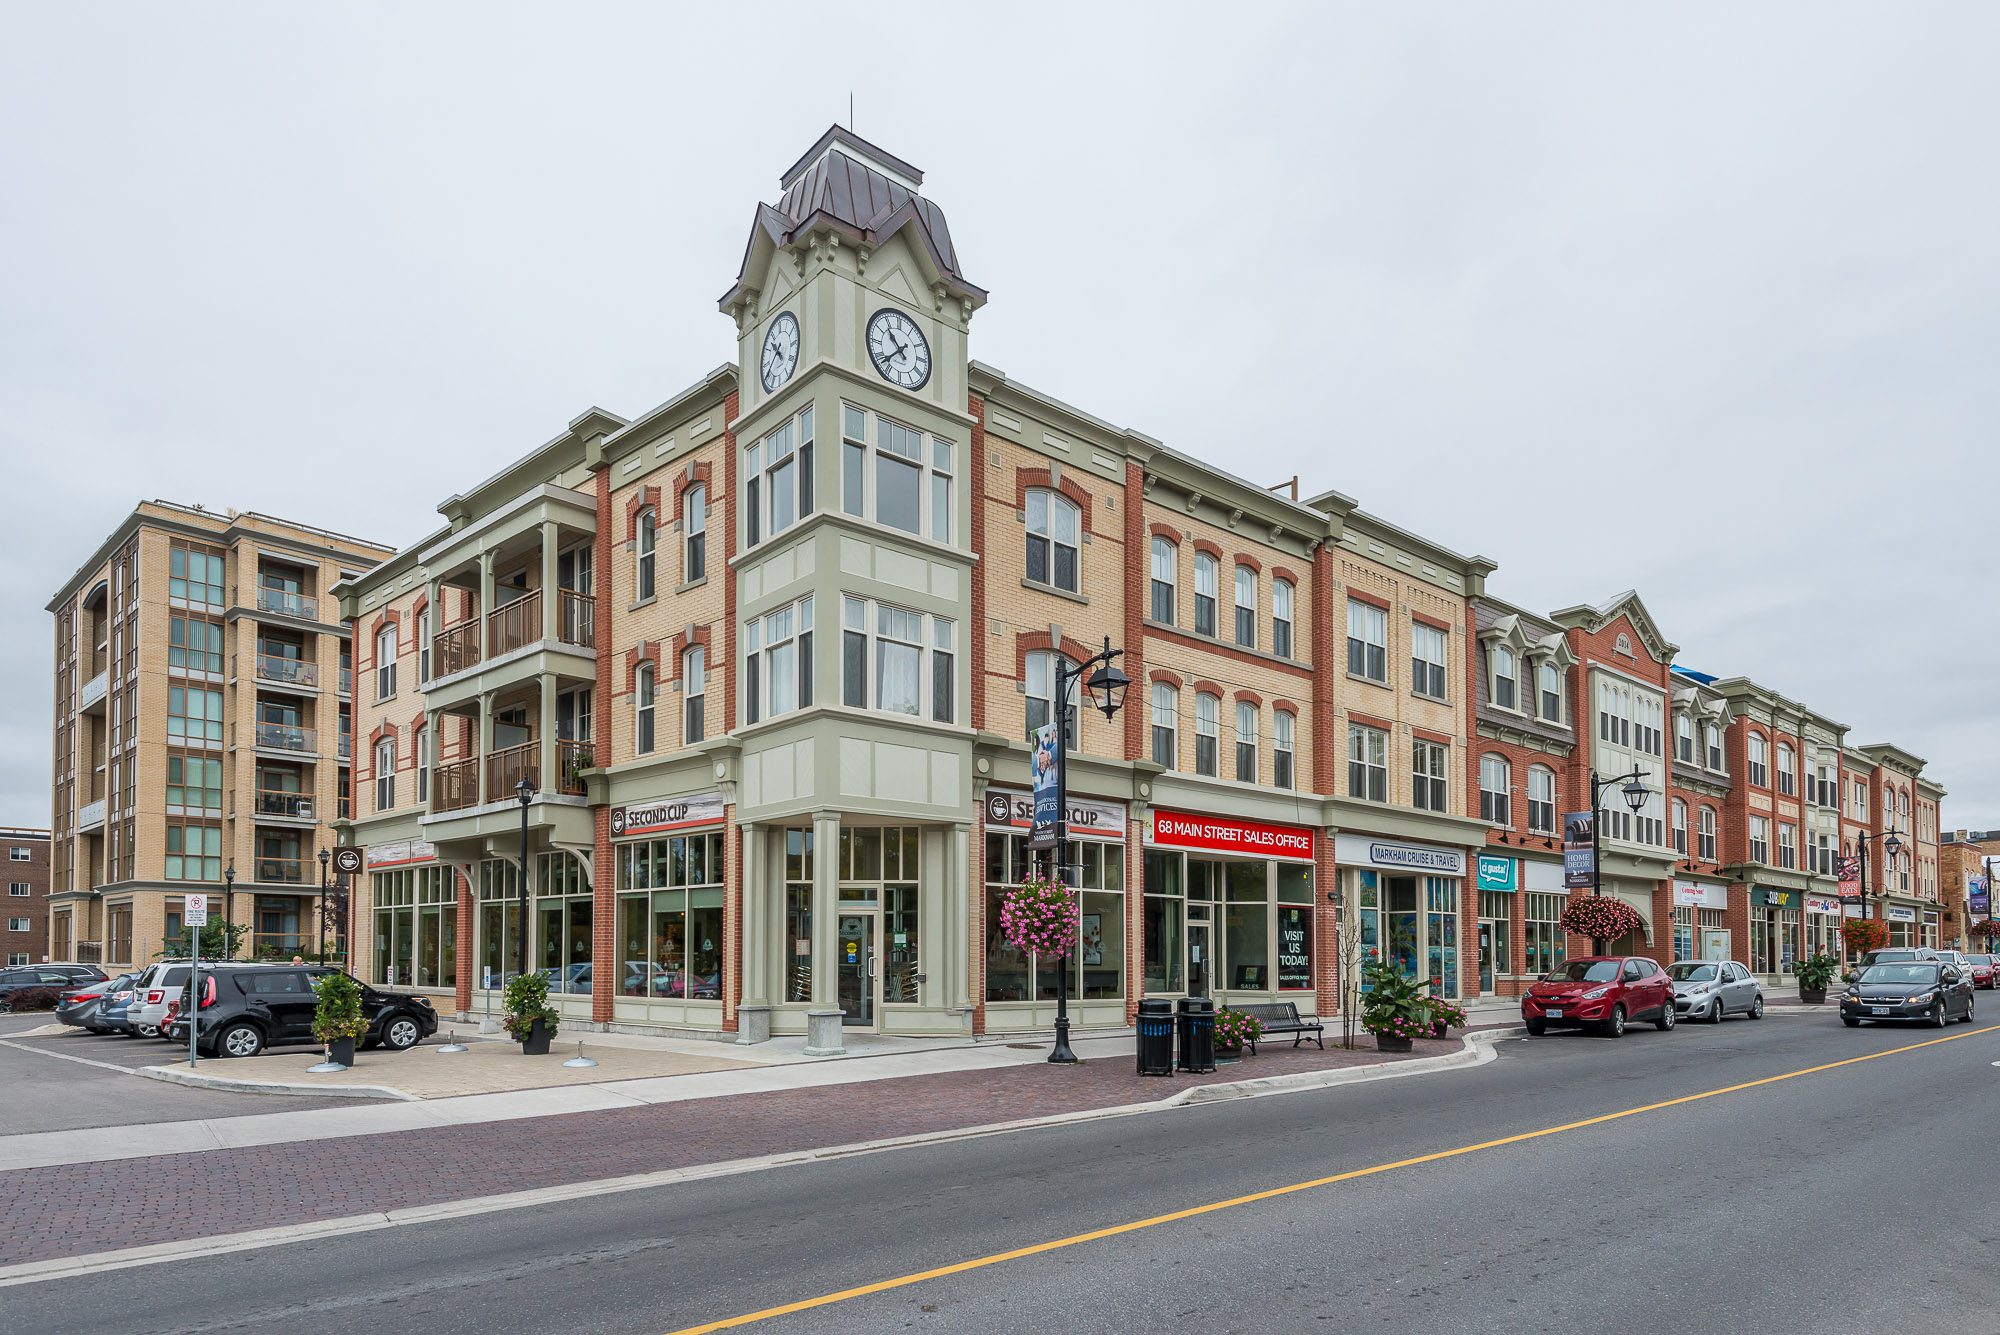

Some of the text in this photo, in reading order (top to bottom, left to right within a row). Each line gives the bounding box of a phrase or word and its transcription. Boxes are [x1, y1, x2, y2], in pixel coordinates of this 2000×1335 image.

[628, 803, 689, 827] SECOND CUP
[1072, 808, 1098, 826] CUP
[1158, 819, 1173, 834] 68
[1174, 821, 1203, 838] MAIN
[1204, 825, 1243, 842] STREET
[1244, 829, 1274, 846] SALES
[1275, 833, 1309, 850] OFFICE
[1375, 847, 1457, 867] MARKHAM CRUISE & TRAVEL
[1567, 853, 1590, 862] HOME
[1567, 861, 1590, 869] DECOR
[1284, 930, 1304, 941] VISIT
[1289, 943, 1300, 953] US
[1280, 955, 1309, 966] TODAY!
